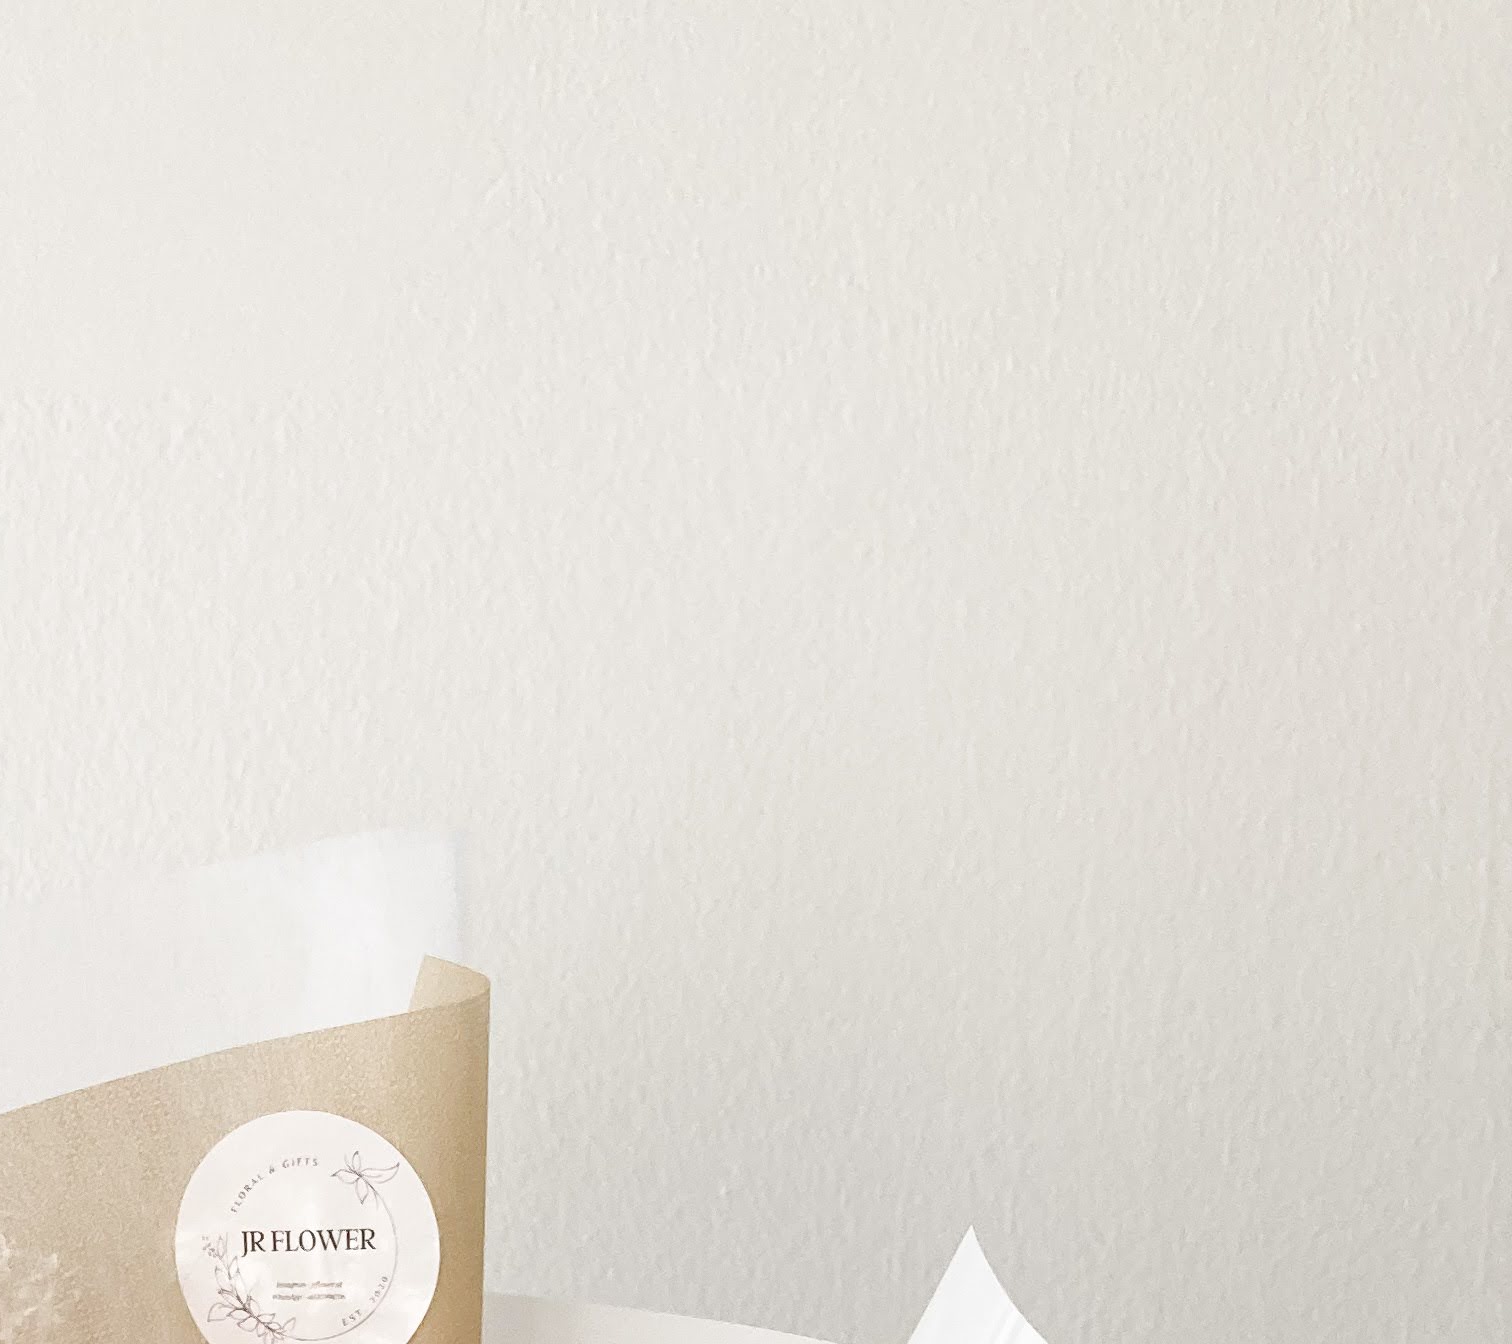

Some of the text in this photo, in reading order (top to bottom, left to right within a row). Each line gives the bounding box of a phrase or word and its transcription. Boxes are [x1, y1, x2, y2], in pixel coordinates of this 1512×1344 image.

[282, 1157, 319, 1169] GIFTS
[241, 1228, 377, 1257] JR FLOWER
